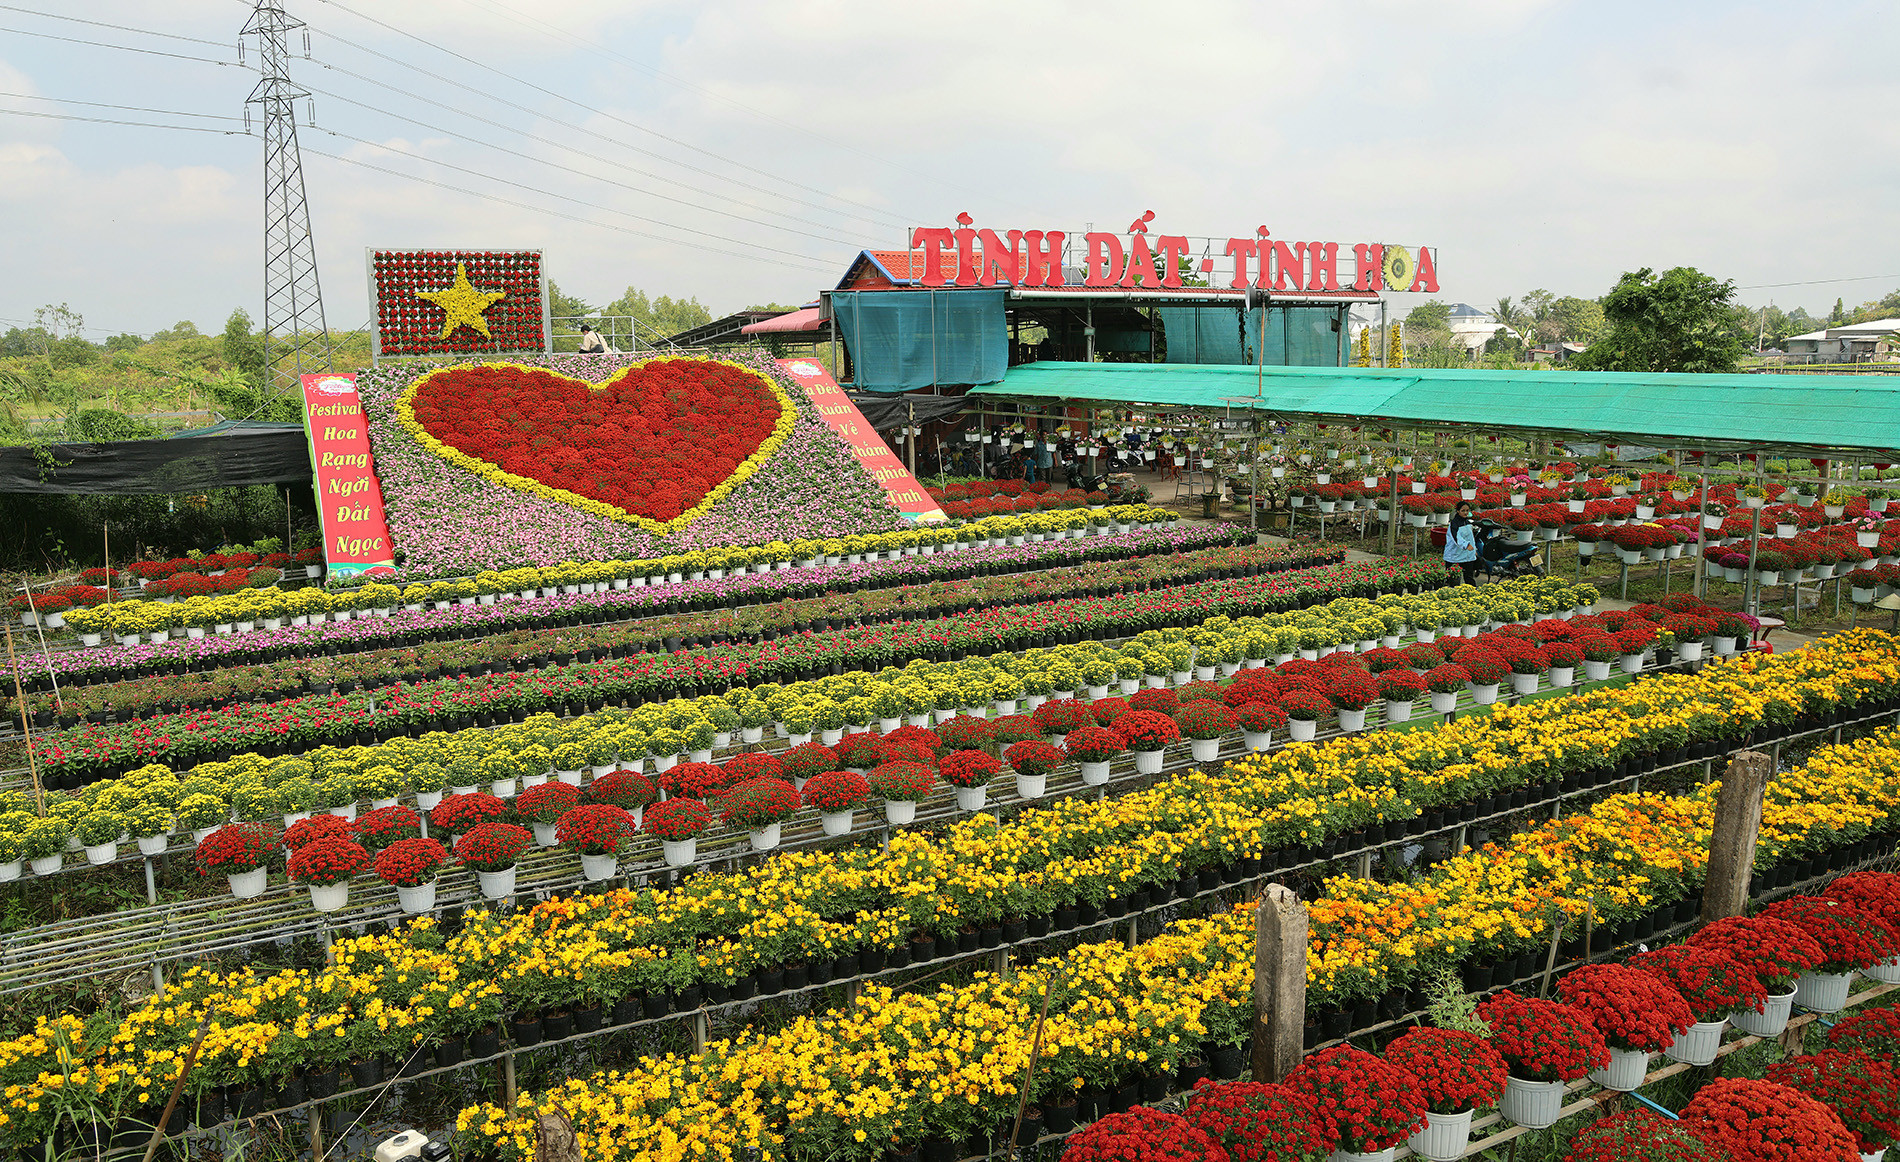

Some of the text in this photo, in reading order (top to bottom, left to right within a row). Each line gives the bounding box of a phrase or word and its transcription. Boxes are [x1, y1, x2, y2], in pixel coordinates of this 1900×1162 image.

[1083, 209, 1190, 289] ĐẤT
[1352, 242, 1441, 293] HOA
[309, 401, 362, 418] Festival
[323, 426, 358, 442] Hoa
[838, 420, 859, 435] Về
[321, 451, 368, 471] Rạng
[865, 465, 909, 484] ghĩa
[328, 475, 370, 498] Ngời
[336, 500, 371, 523] Đất
[335, 535, 384, 557] Ngọc
